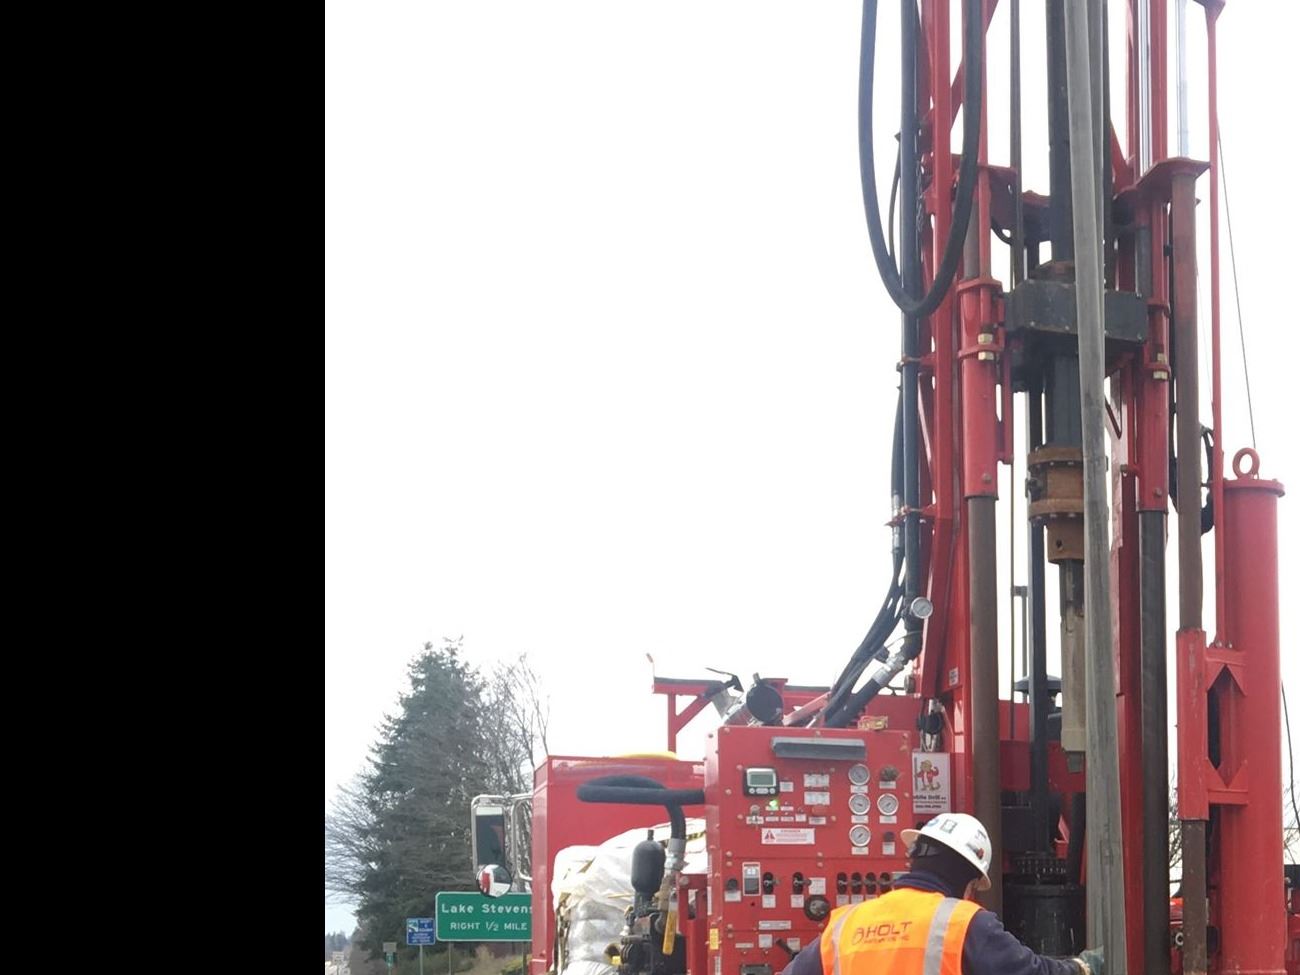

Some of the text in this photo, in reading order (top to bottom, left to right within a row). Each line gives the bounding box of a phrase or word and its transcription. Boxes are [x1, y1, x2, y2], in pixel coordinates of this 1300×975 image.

[441, 903, 474, 914] Lake
[450, 921, 480, 931] RIGHT
[504, 922, 528, 931] MILE
